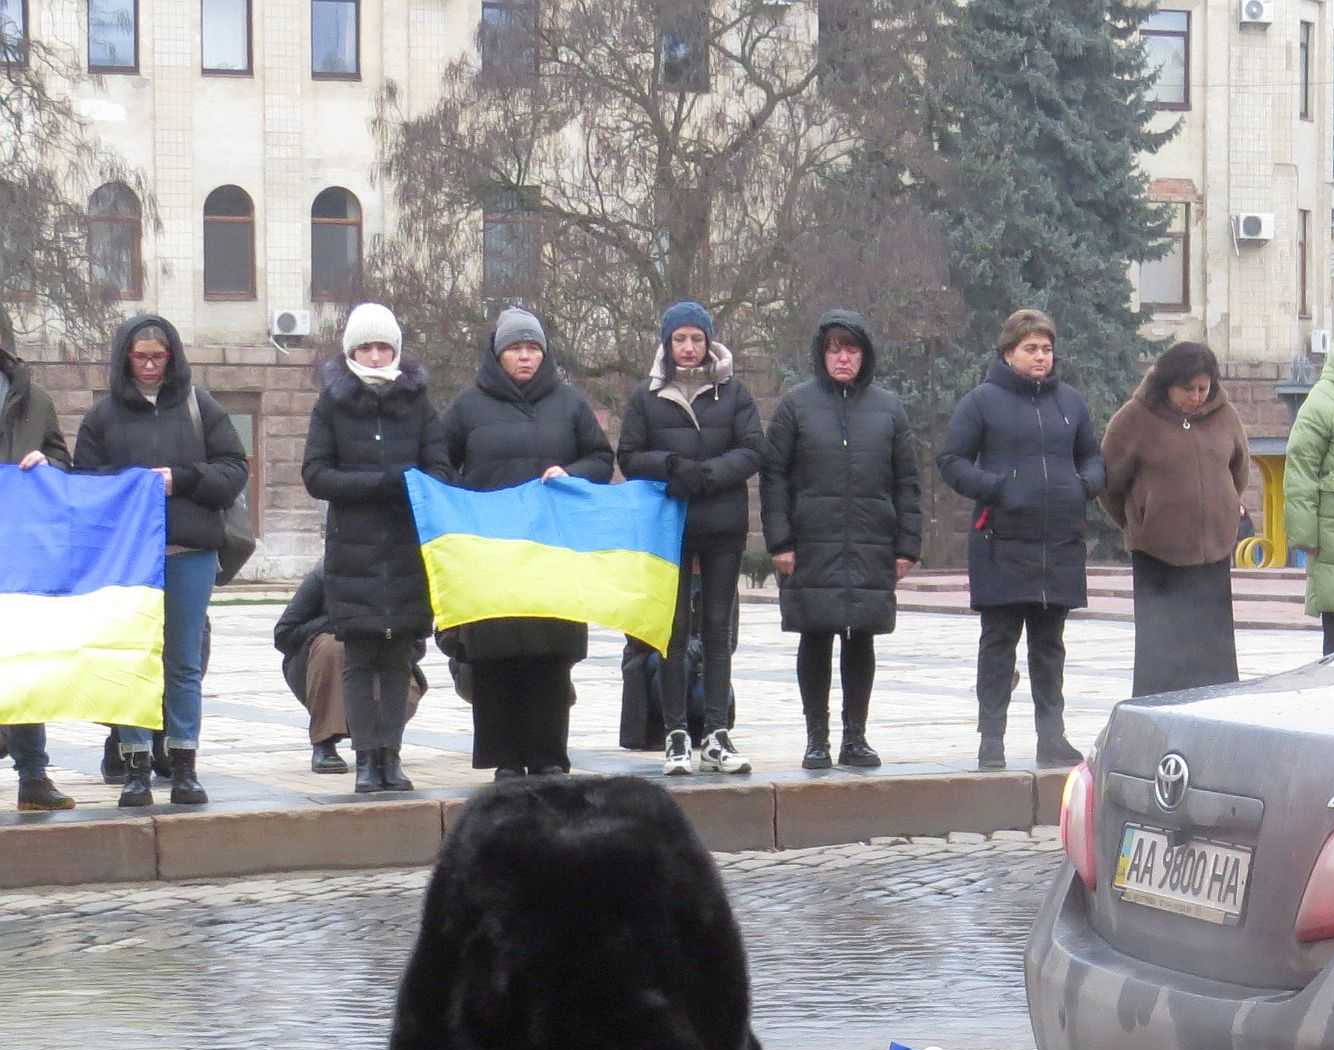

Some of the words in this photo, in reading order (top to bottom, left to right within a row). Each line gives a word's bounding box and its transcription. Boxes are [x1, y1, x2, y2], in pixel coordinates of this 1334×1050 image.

[1126, 837, 1158, 887] AA
[1158, 846, 1208, 896] 9800
[1208, 853, 1241, 906] HA
